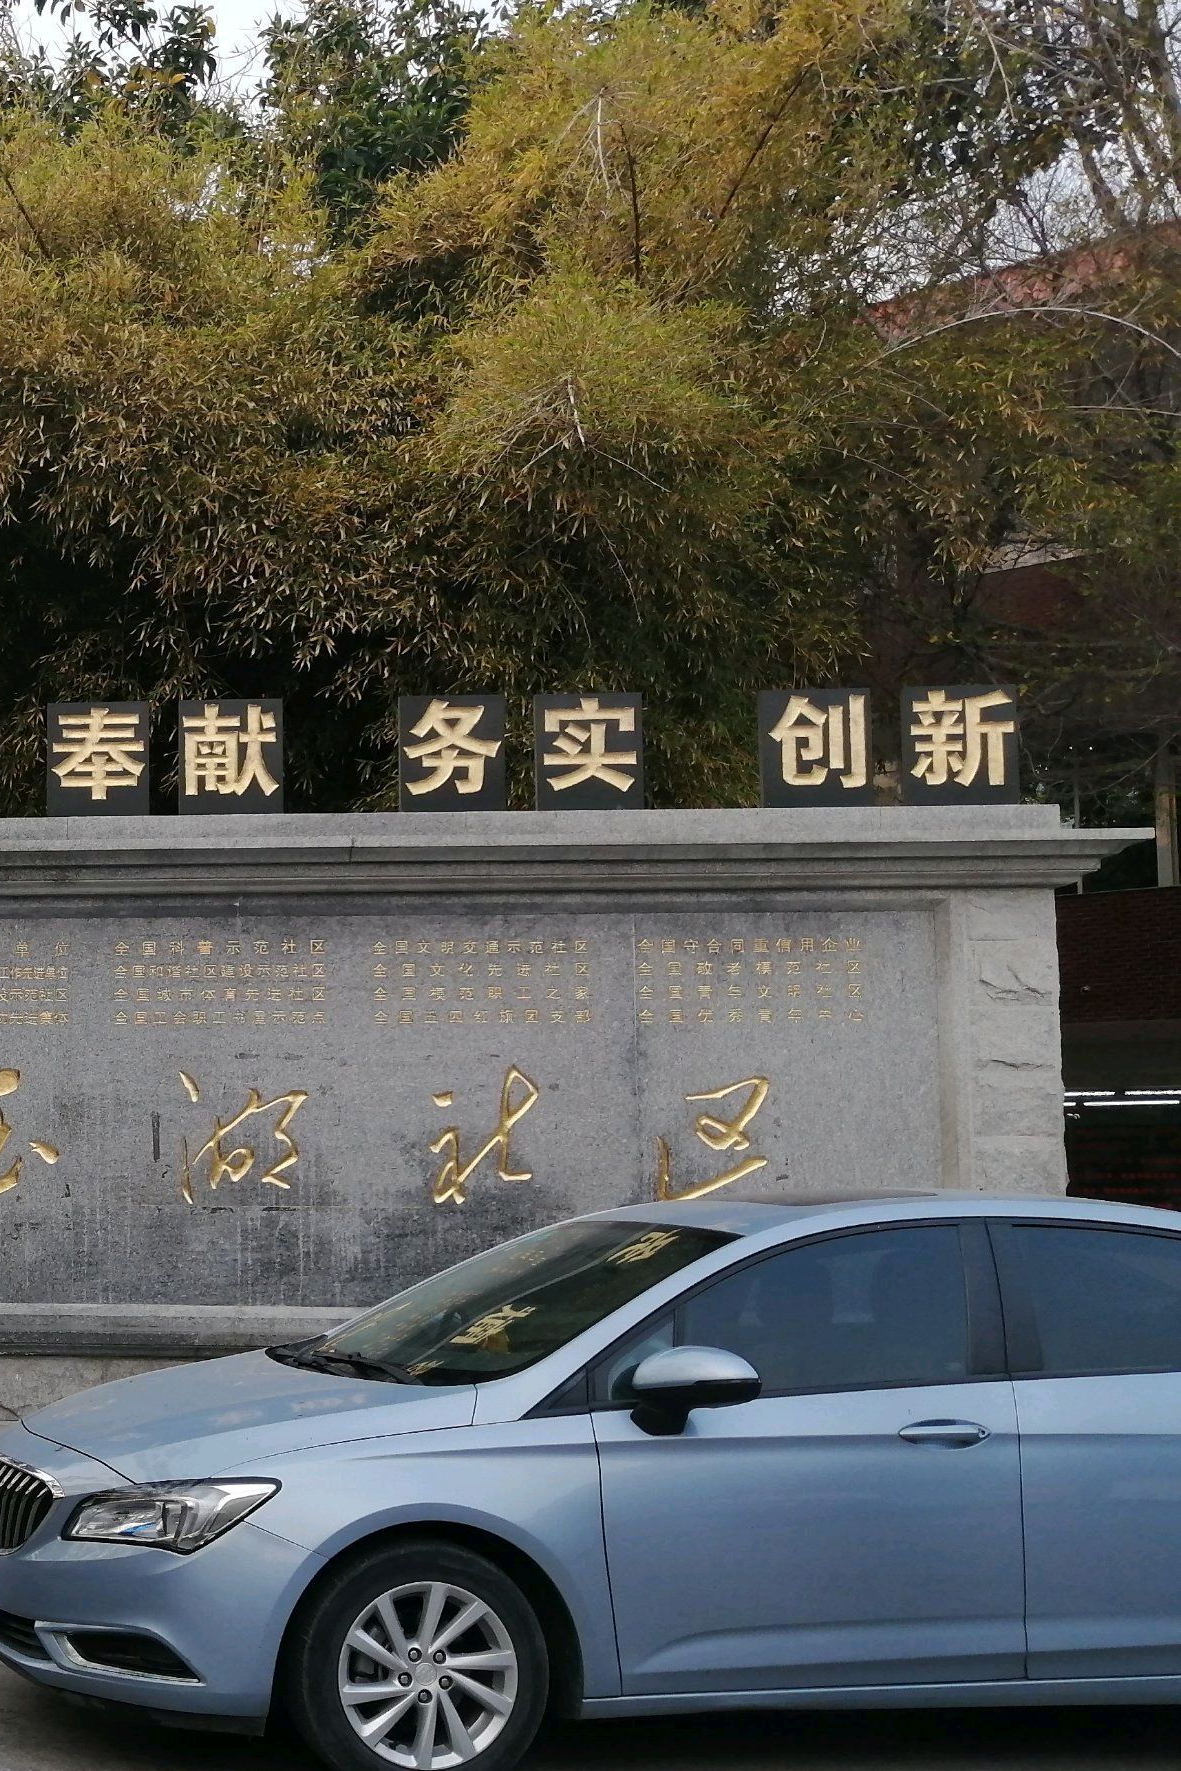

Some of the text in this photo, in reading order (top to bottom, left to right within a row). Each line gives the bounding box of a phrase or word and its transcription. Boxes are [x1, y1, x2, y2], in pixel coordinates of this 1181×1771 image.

[52, 704, 279, 800] 奉献
[403, 697, 637, 795] 务实
[769, 689, 1014, 788] 创新
[115, 939, 325, 955] 全国科普示范社区
[372, 940, 588, 955] 全国文明交通示范社区
[637, 937, 861, 954] 全国守合同重信用企业
[114, 963, 326, 978] 全国和谐社区建设示范社区
[372, 962, 589, 977] 全国文化先进社区
[638, 960, 861, 976] 全国敬老模范社区
[114, 987, 326, 1002] 全国城市体育先进社区
[373, 986, 590, 1001] 全国模范职工之家
[638, 983, 861, 999] 全国青年文明社区
[115, 1010, 327, 1025] 全国工会职工书屋示范点
[374, 1009, 590, 1024] 全国五四红旗团支部
[638, 1008, 864, 1023] 全国优秀青年中心
